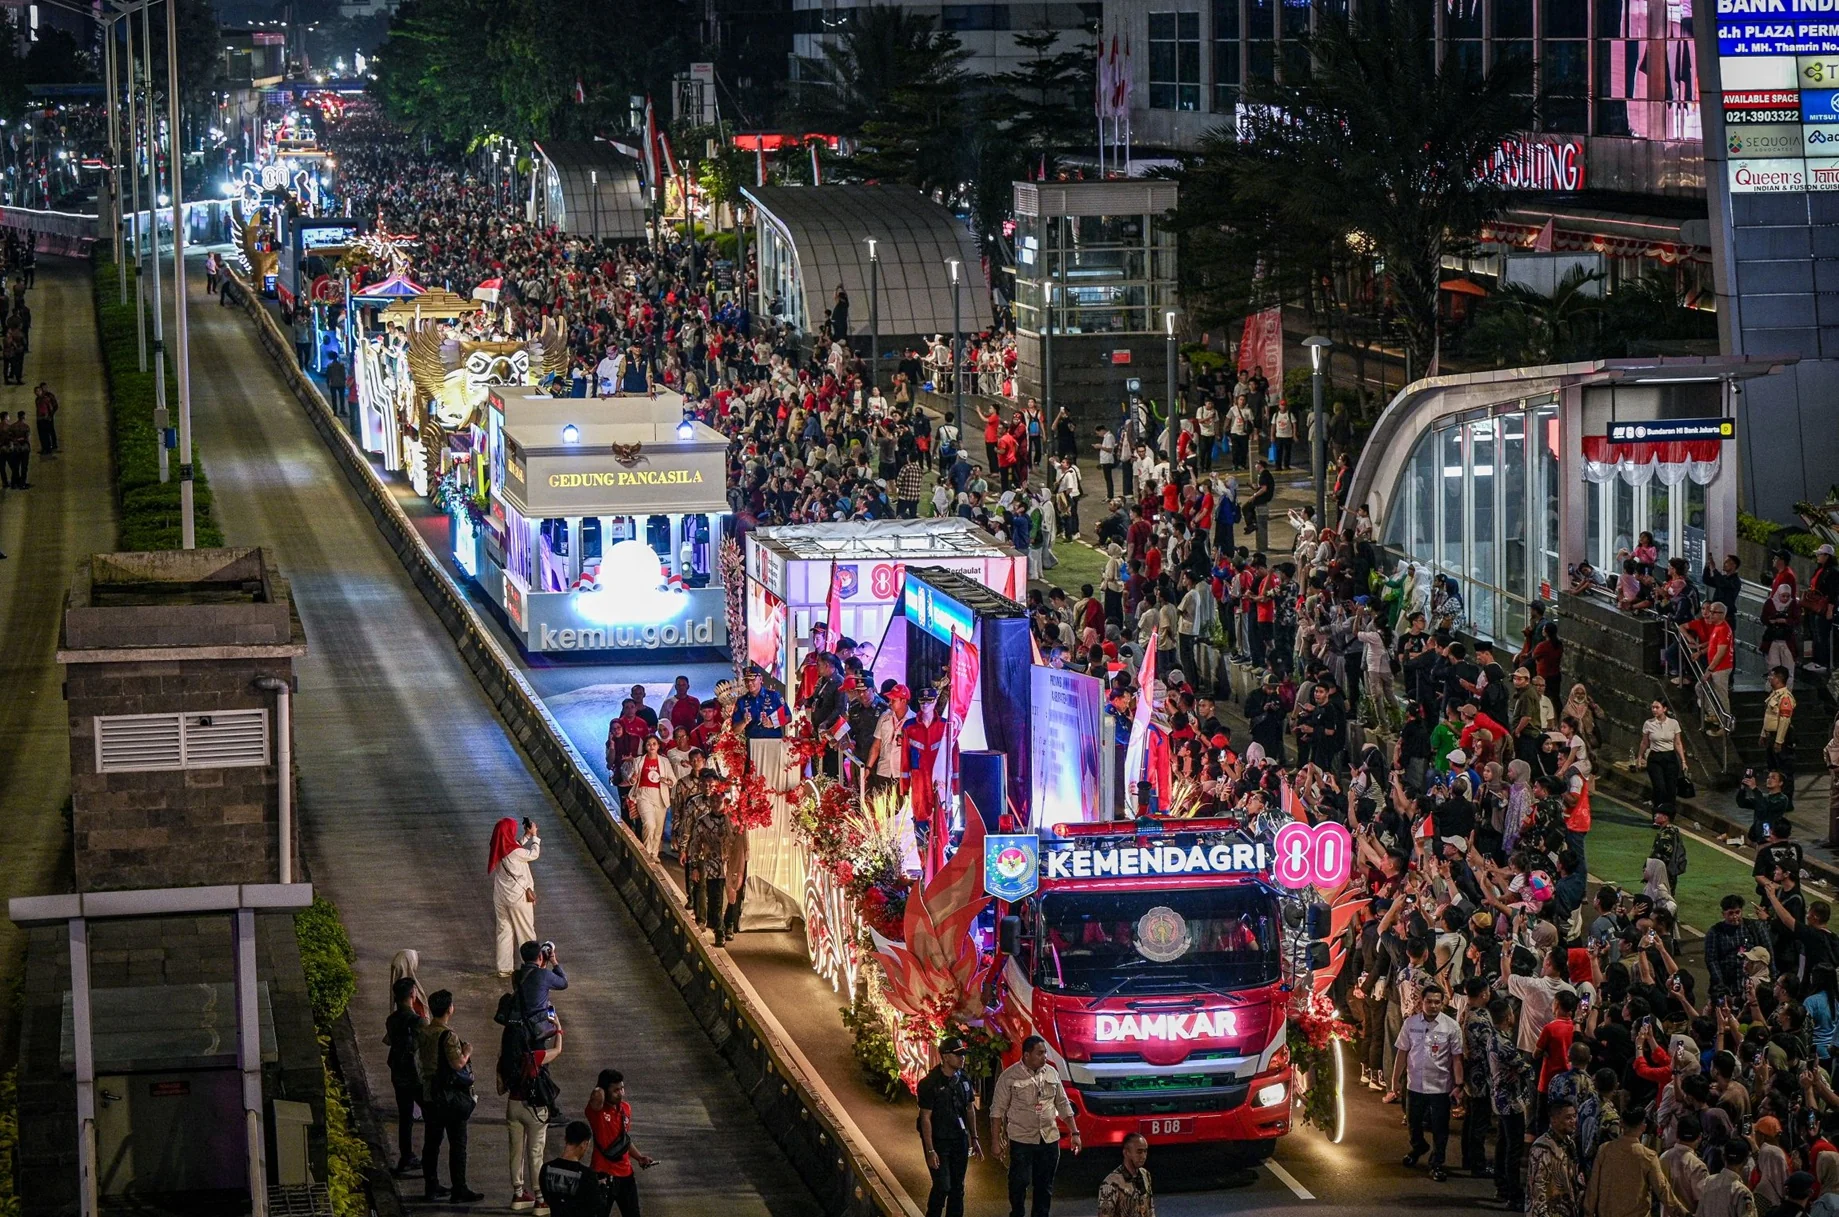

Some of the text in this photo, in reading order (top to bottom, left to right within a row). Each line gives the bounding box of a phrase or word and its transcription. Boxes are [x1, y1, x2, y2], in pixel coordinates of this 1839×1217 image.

[1717, 0, 1786, 13] BANK
[1718, 26, 1741, 38] d.h
[1745, 25, 1795, 38] PLAZA
[1751, 43, 1773, 52] MH.
[1775, 42, 1819, 52] Thamrin
[1723, 94, 1799, 104] AVAILABLE SPACE
[1726, 111, 1799, 122] 021-3903322
[1746, 136, 1801, 147] SEQUOIA
[1735, 168, 1802, 186] Queen's
[1699, 426, 1720, 434] Jakarta
[549, 470, 703, 488] GEDUNG PANCASILA
[540, 616, 713, 650] kemlu.go.id
[1048, 843, 1265, 878] KEMENDAGRI
[1273, 821, 1352, 890] 80
[1096, 1011, 1238, 1041] DAMKAR
[1151, 1120, 1180, 1134] B 08
